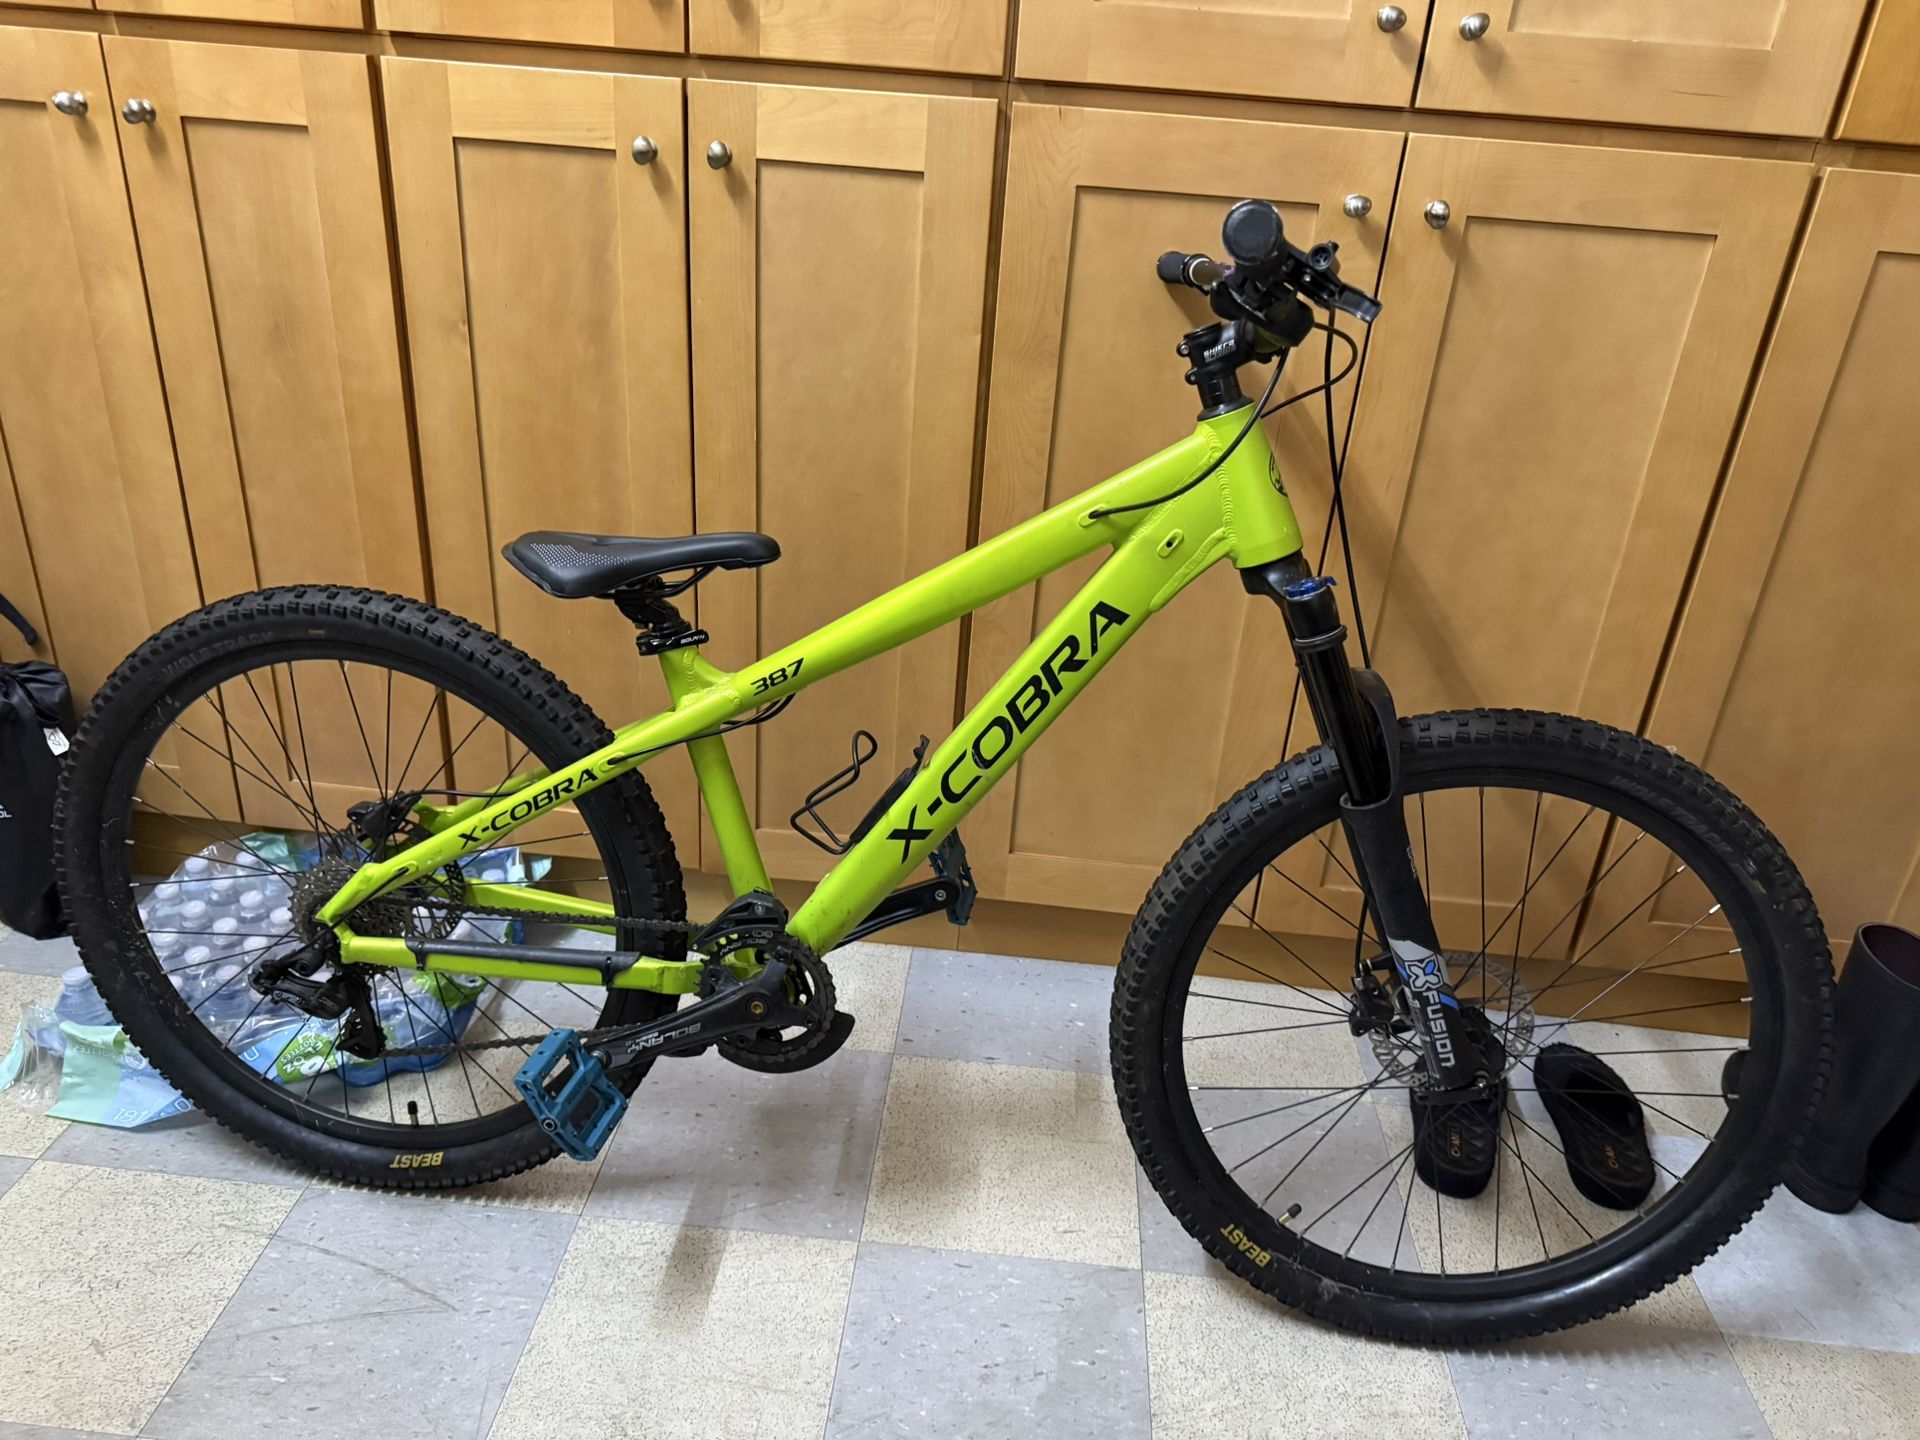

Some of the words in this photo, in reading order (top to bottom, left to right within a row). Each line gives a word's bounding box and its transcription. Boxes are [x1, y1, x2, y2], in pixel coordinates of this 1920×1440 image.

[750, 657, 805, 697] 387
[886, 600, 1131, 865] X-COBRA
[457, 767, 599, 850] X-COBRA
[389, 1151, 444, 1168] BEAST
[1220, 1223, 1272, 1267] BEAST
